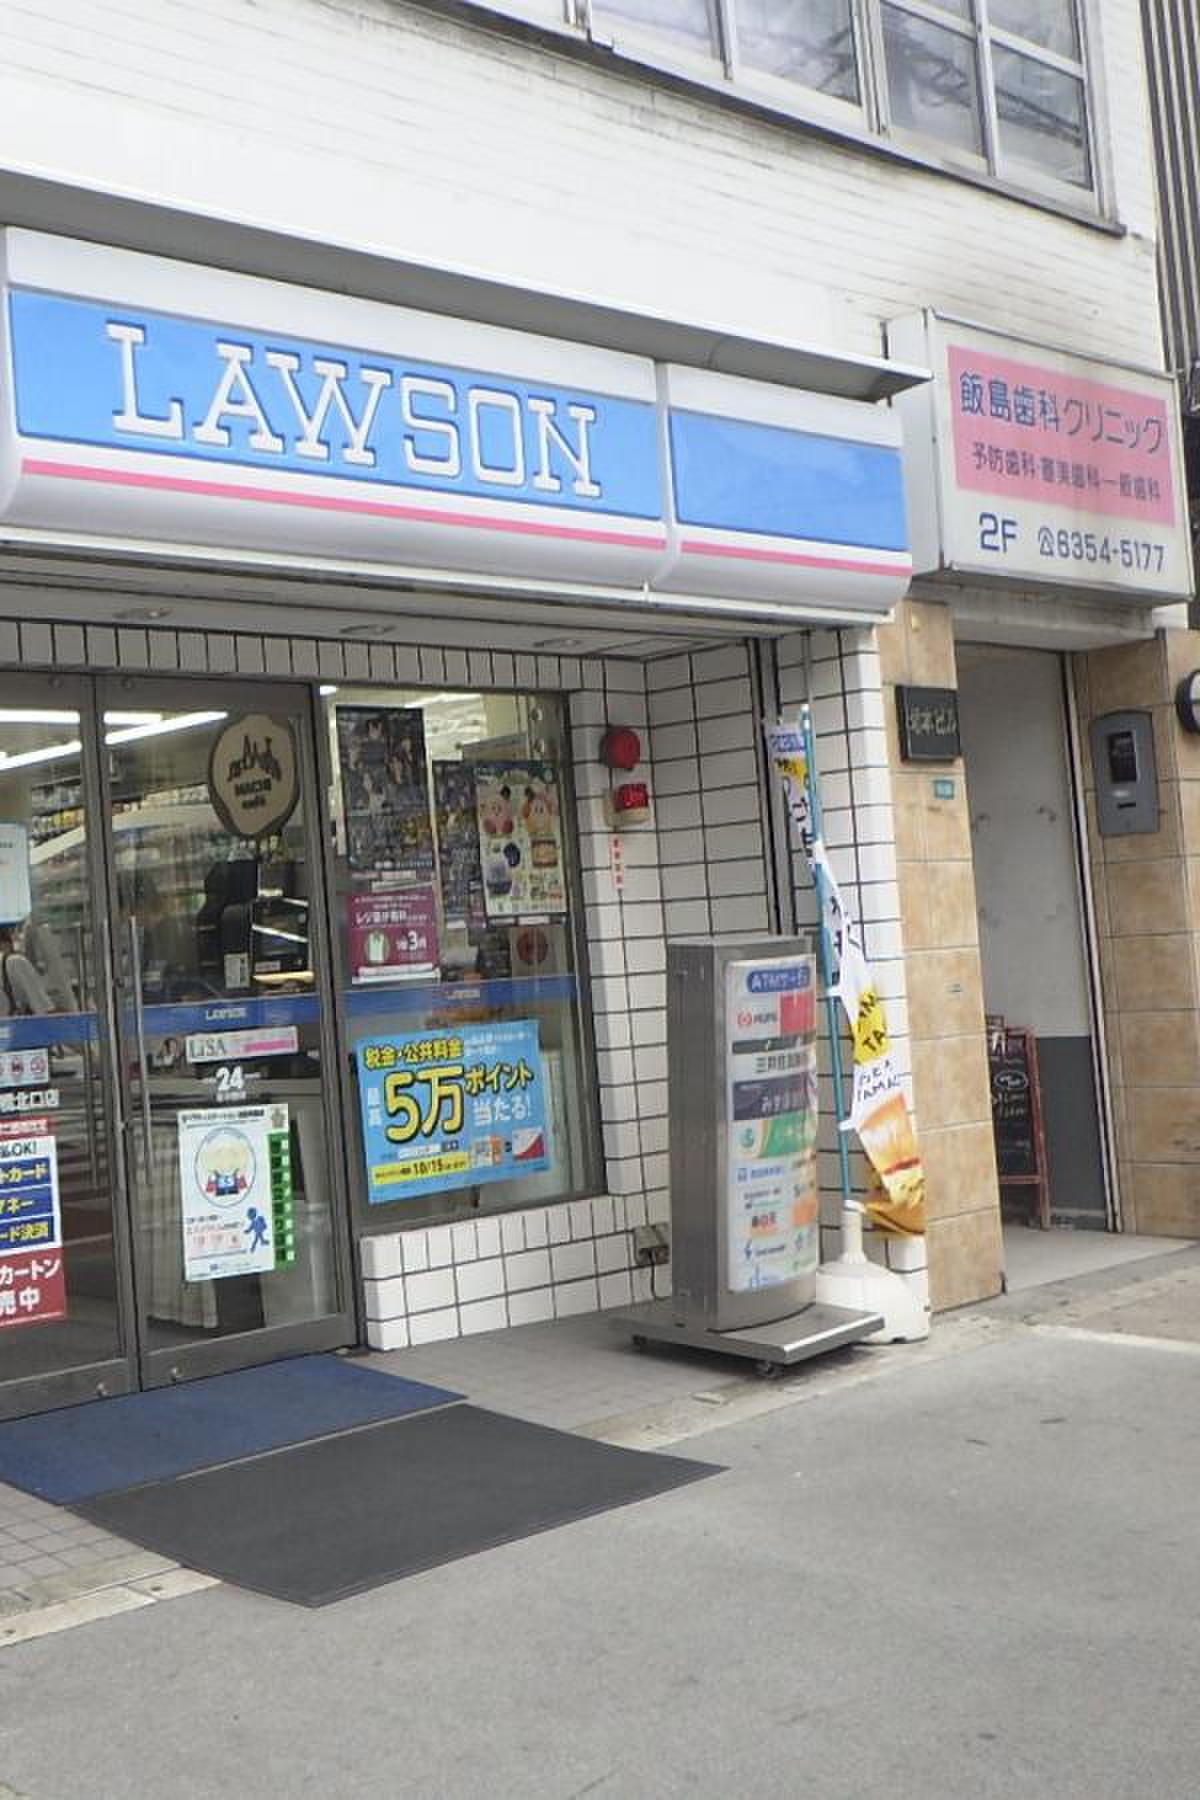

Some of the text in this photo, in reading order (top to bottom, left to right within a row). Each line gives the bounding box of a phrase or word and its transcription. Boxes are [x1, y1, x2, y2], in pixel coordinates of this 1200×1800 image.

[104, 319, 602, 498] LAWSON
[959, 371, 1163, 454] 飯島歯科クリニック
[978, 512, 1018, 553] 2F
[215, 1065, 245, 1091] 24
[384, 1059, 534, 1143] 5万 ポイント
